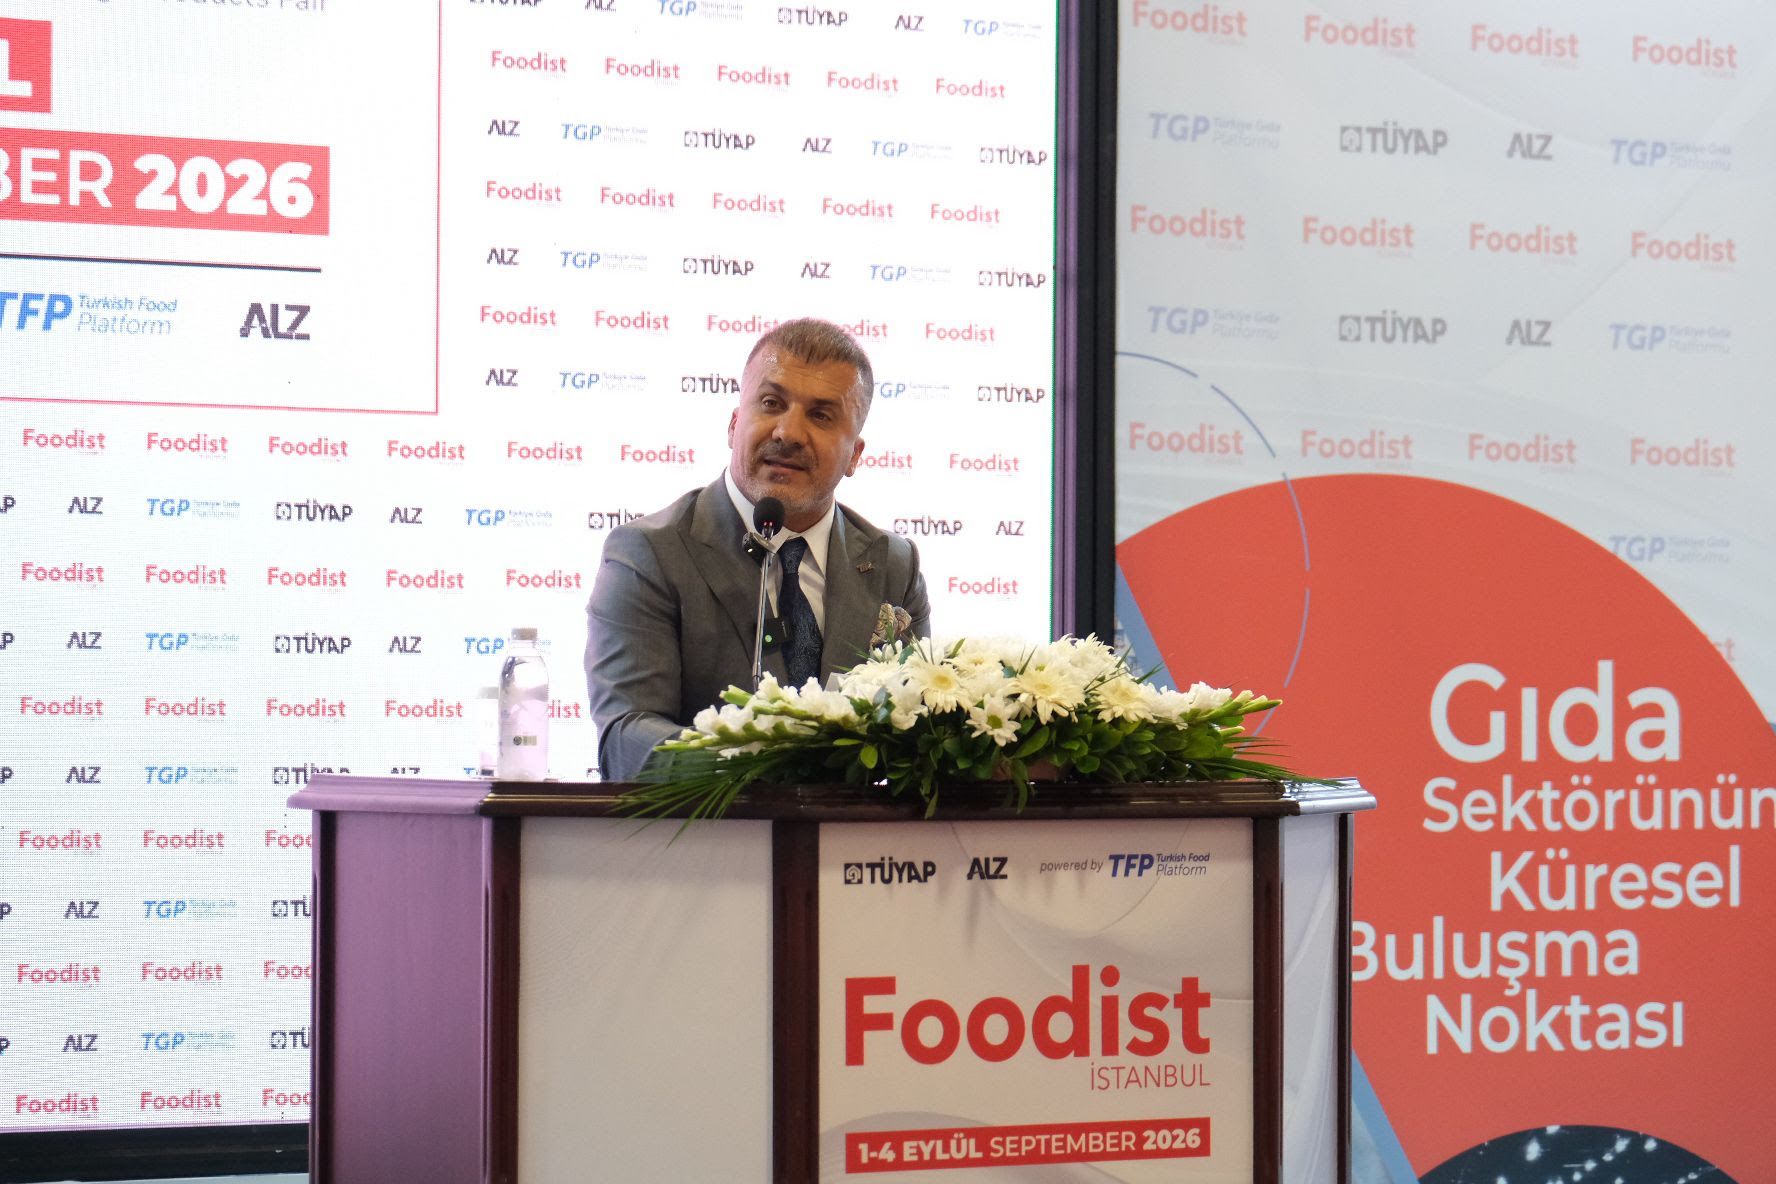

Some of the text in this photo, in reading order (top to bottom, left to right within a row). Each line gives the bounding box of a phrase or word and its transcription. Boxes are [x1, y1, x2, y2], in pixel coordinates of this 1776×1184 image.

[660, 0, 697, 15] TGP
[964, 19, 999, 35] TGP
[1132, 0, 1246, 36] Foodist
[1304, 15, 1415, 48] Foodist
[1471, 24, 1578, 58] Foodist
[492, 51, 566, 72] Foodist
[1633, 36, 1737, 69] Foodist
[605, 57, 679, 79] Foodist
[718, 65, 790, 85] Foodist
[827, 71, 898, 92] Foodist
[936, 78, 1005, 98] Foodist
[563, 124, 601, 140] TGP
[1149, 113, 1210, 142] TGP
[1365, 121, 1448, 155] TÜYAP
[1507, 133, 1552, 160] ALZ
[872, 141, 908, 157] TGP
[1610, 139, 1667, 166] TGP
[134, 154, 314, 218] 2026
[486, 181, 561, 201] Foodist
[601, 187, 674, 207] Foodist
[713, 193, 784, 213] Foodist
[822, 198, 893, 218] Foodist
[931, 203, 999, 223] Foodist
[1130, 204, 1245, 240] Foodist
[1303, 216, 1413, 248] Foodist
[1470, 223, 1577, 255] Foodist
[1631, 231, 1736, 262] Foodist
[561, 251, 600, 268] TGP
[871, 265, 907, 281] TGP
[79, 294, 177, 312] Turkish Food
[78, 311, 172, 335] Platform
[240, 303, 310, 340] ALZ
[480, 306, 556, 325] Foodist
[595, 311, 669, 330] Foodist
[1147, 306, 1209, 334] TGP
[926, 323, 994, 342] Foodist
[1364, 310, 1447, 344] TÜYAP
[1506, 320, 1551, 346] ALZ
[1610, 324, 1666, 350] TGP
[560, 372, 599, 389] TGP
[23, 429, 105, 449] Foodist
[147, 432, 227, 453] Foodist
[269, 436, 347, 456] Foodist
[1129, 422, 1243, 455] Foodist
[1301, 429, 1412, 459] Foodist
[1468, 433, 1576, 464] Foodist
[388, 440, 464, 460] Foodist
[508, 441, 582, 461] Foodist
[621, 445, 694, 463] Foodist
[1631, 438, 1734, 467] Foodist
[950, 453, 1019, 472] Foodist
[147, 499, 190, 516] TGP
[466, 509, 505, 526] TGP
[1609, 536, 1665, 562] TGP
[22, 562, 103, 582] Foodist
[146, 565, 226, 584] Foodist
[268, 567, 346, 587] Foodist
[386, 569, 463, 589] Foodist
[506, 569, 581, 588] Foodist
[948, 577, 1018, 594] Foodist
[146, 633, 189, 650] TGP
[465, 637, 504, 654] TGP
[20, 696, 103, 715] Foodist
[145, 697, 226, 716] Foodist
[267, 698, 345, 717] Foodist
[385, 699, 463, 717] Foodist
[1430, 660, 1680, 763] Gıda
[146, 767, 188, 784] TGP
[1423, 774, 1776, 832] Sektörünün
[19, 830, 101, 850] Foodist
[143, 829, 224, 849] Foodist
[1040, 858, 1104, 874] powered by
[1109, 853, 1155, 877] TFP
[1156, 853, 1188, 863] Turkish
[1190, 852, 1210, 862] Food
[866, 857, 936, 884] TÜYAP
[967, 857, 1008, 880] ALZ
[1156, 863, 1207, 876] Platform
[1491, 845, 1740, 911] Küresel
[143, 901, 186, 918] TGP
[18, 963, 100, 983] Foodist
[142, 961, 222, 981] Foodist
[845, 964, 1211, 1066] Foodist
[1426, 988, 1683, 1055] Noktası
[142, 1032, 185, 1050] TGP
[1091, 1062, 1211, 1091] İSTANBUL
[16, 1093, 98, 1113] Foodist
[141, 1090, 221, 1110] Foodist
[859, 1128, 1200, 1163] 1-4 EYLÜL SEPTEMBER 2026
